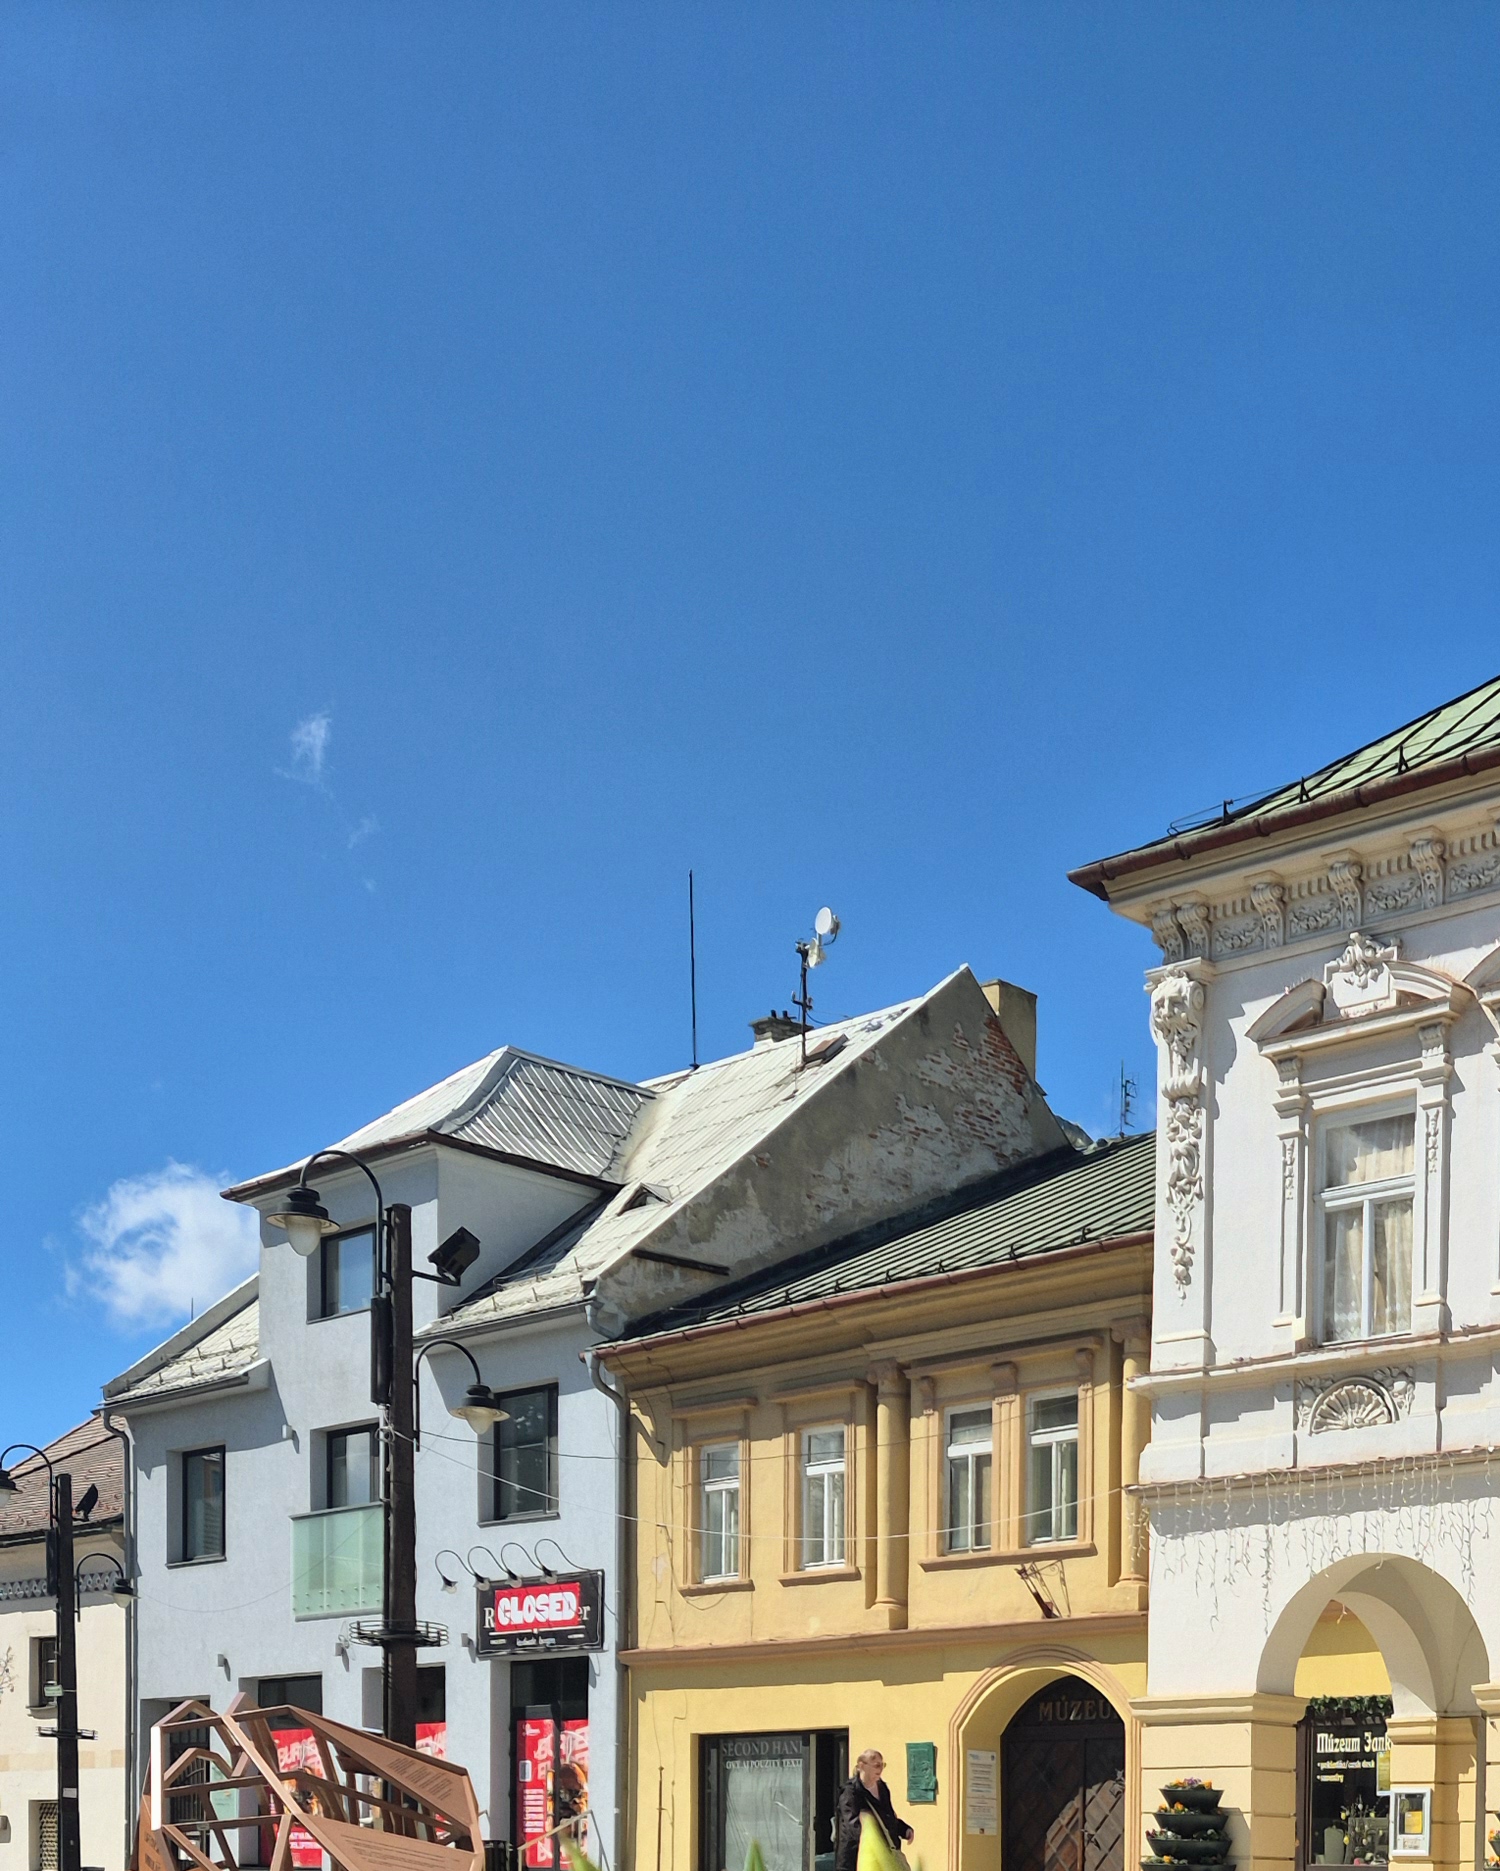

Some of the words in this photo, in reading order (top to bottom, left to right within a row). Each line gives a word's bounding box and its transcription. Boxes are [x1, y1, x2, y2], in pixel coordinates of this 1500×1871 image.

[497, 1591, 577, 1626] CLOSED
[1038, 1695, 1118, 1721] MÚZEU
[1316, 1732, 1361, 1754] Múzeum
